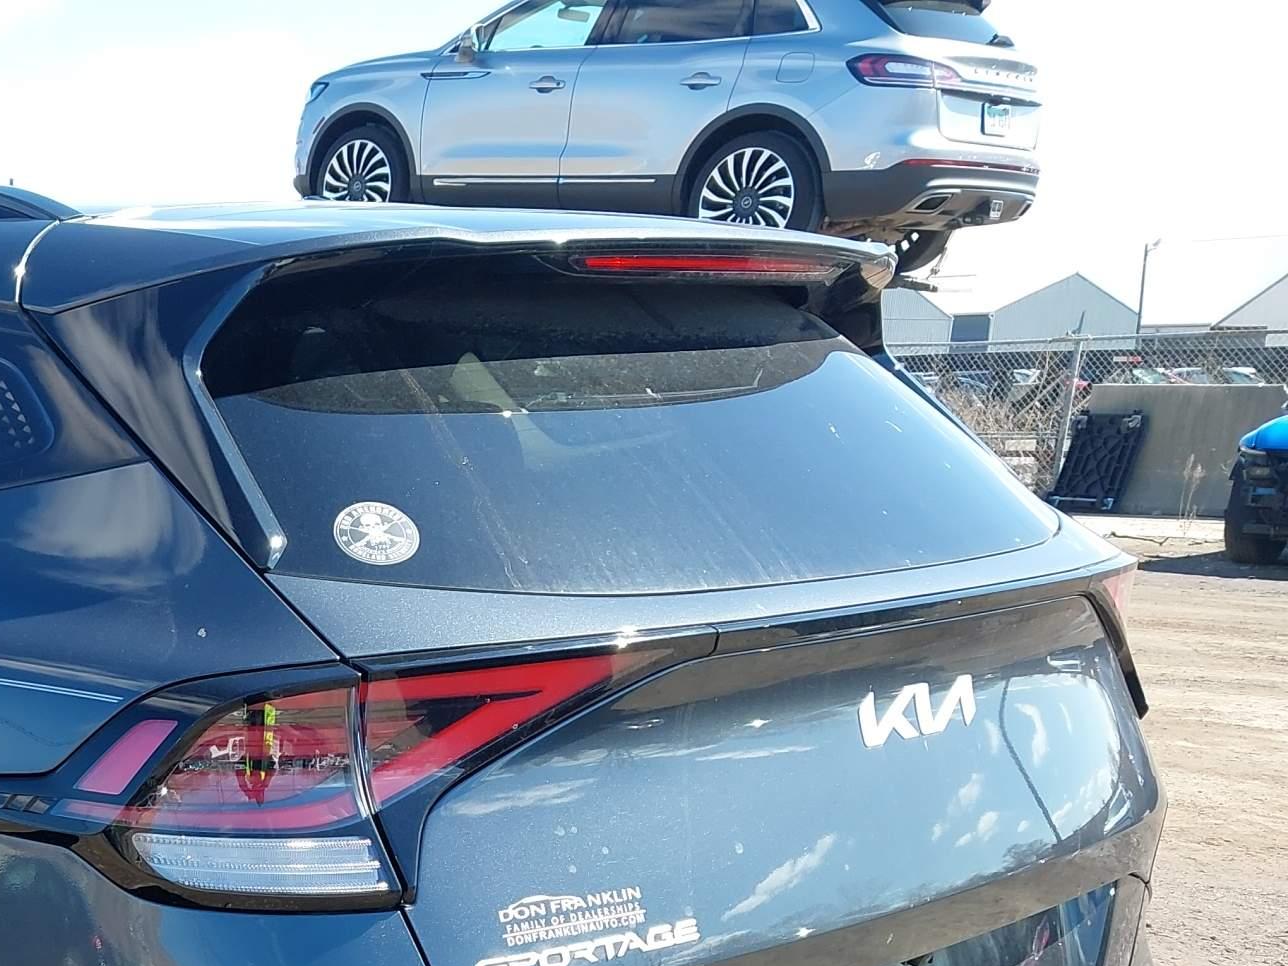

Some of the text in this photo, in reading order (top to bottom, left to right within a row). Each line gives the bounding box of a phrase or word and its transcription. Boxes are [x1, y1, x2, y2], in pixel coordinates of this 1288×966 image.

[498, 886, 642, 924] DON FRANKLIN
[505, 901, 641, 935] FAMILY OF DEALERSHIPS
[506, 913, 646, 947] DONFRANKLINAUTO.COM
